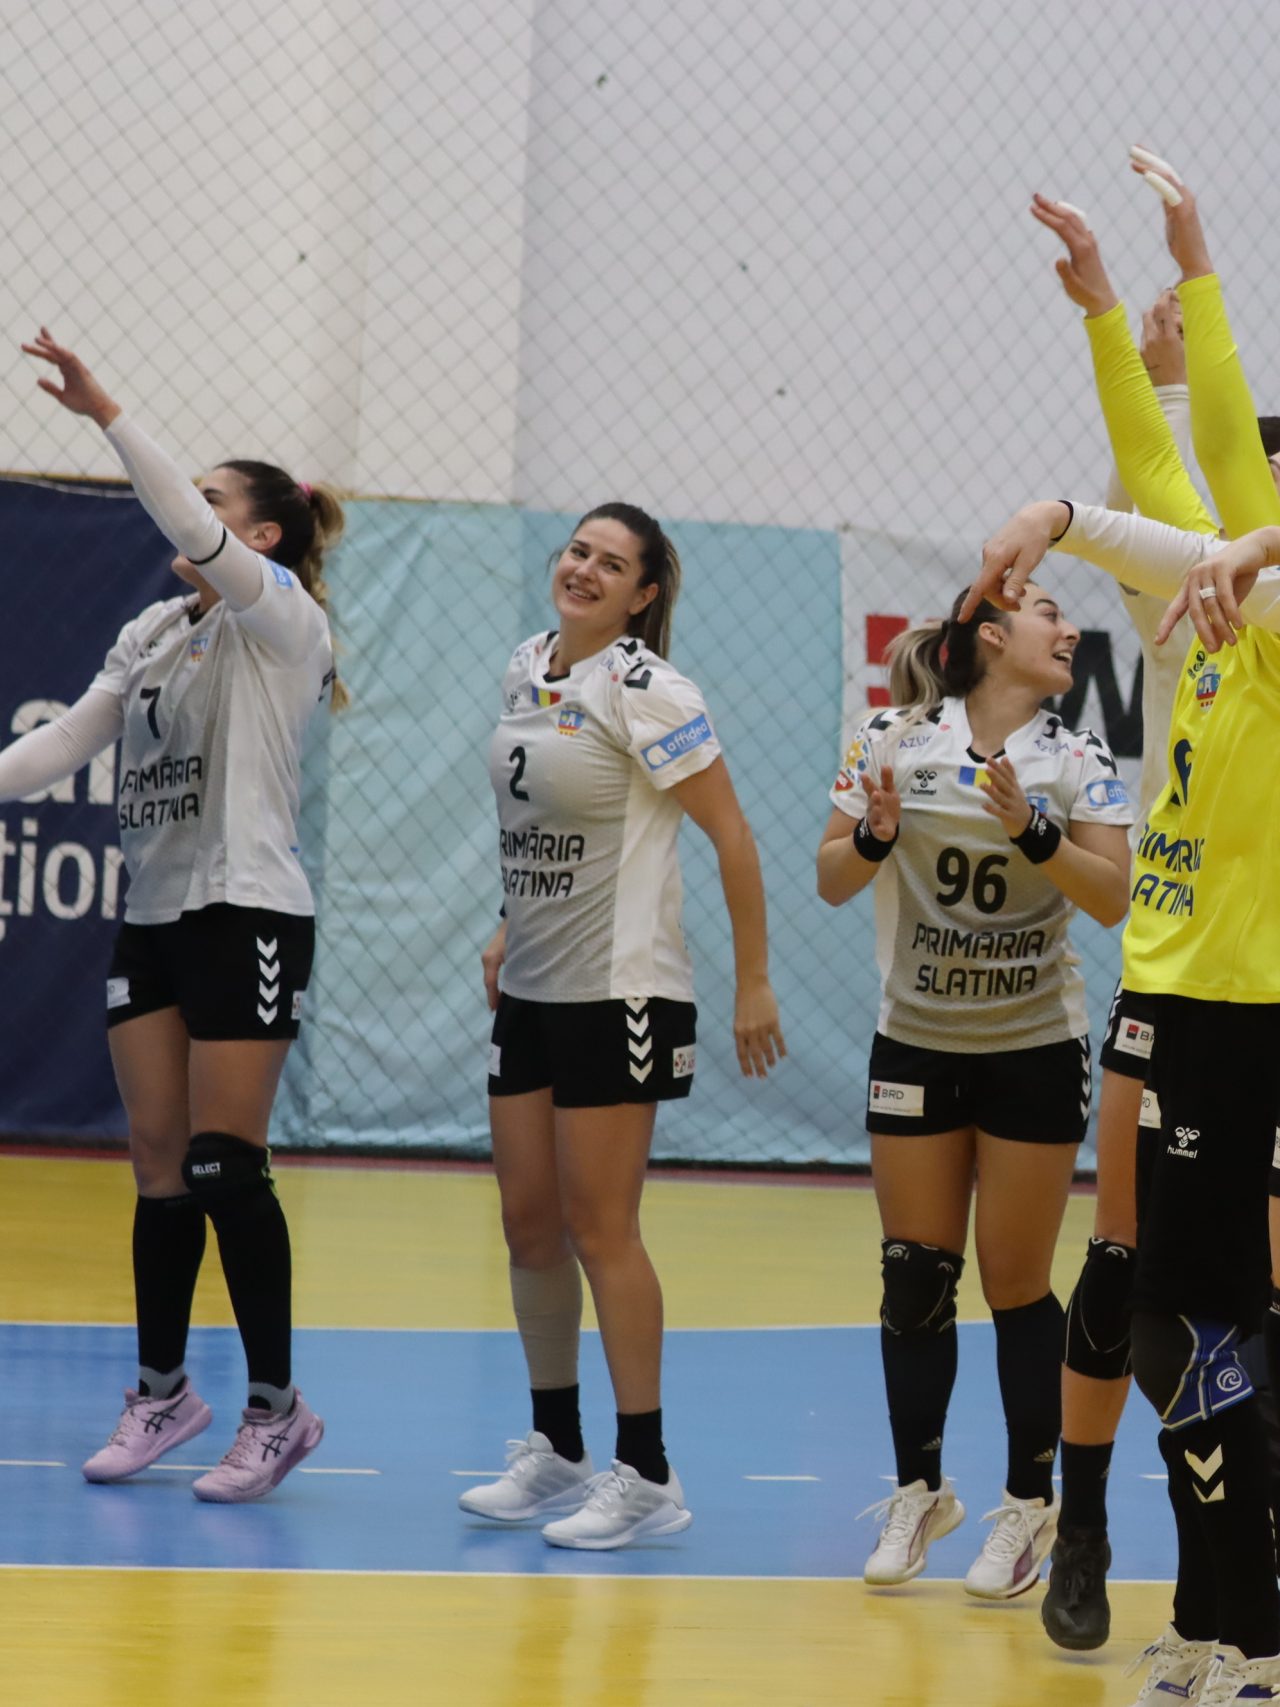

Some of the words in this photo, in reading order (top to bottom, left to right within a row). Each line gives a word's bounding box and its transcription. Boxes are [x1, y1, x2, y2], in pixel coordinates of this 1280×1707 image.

[139, 686, 162, 739] 7
[509, 745, 530, 802] 2
[500, 826, 585, 862] RIMĂRIA
[936, 847, 1010, 915] 96
[911, 922, 1046, 960] PRIMĂRIA
[914, 964, 1038, 997] SLATINA
[881, 1088, 905, 1101] BRD
[1167, 1144, 1198, 1159] hummel
